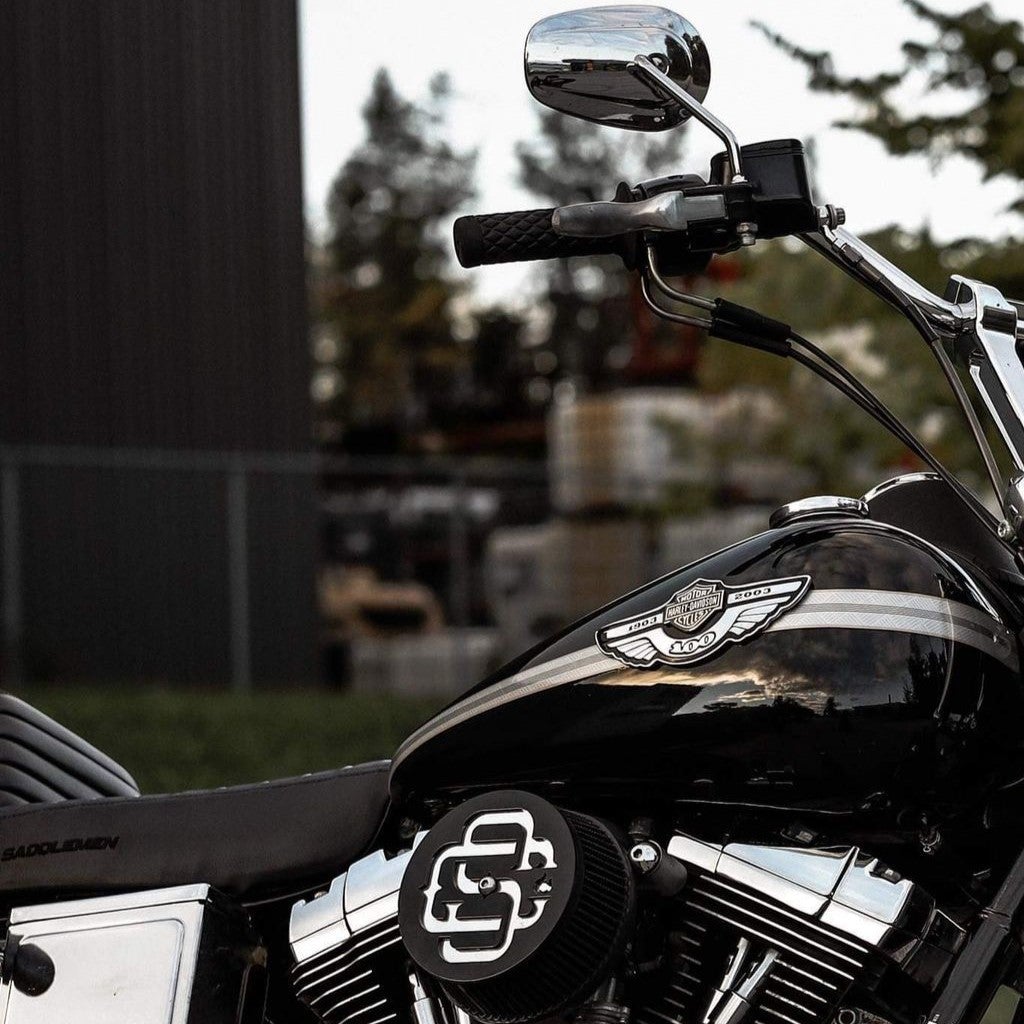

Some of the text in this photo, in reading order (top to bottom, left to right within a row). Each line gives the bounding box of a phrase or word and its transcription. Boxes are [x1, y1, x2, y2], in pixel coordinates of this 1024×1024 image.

[680, 587, 711, 601] MOTOR
[734, 587, 771, 600] 2003
[668, 595, 719, 617] HARLEY-DAVIDSON
[627, 616, 658, 632] 1903
[676, 610, 709, 626] CYCLES
[669, 631, 717, 655] 100
[1, 836, 120, 862] SADDLEMEN
